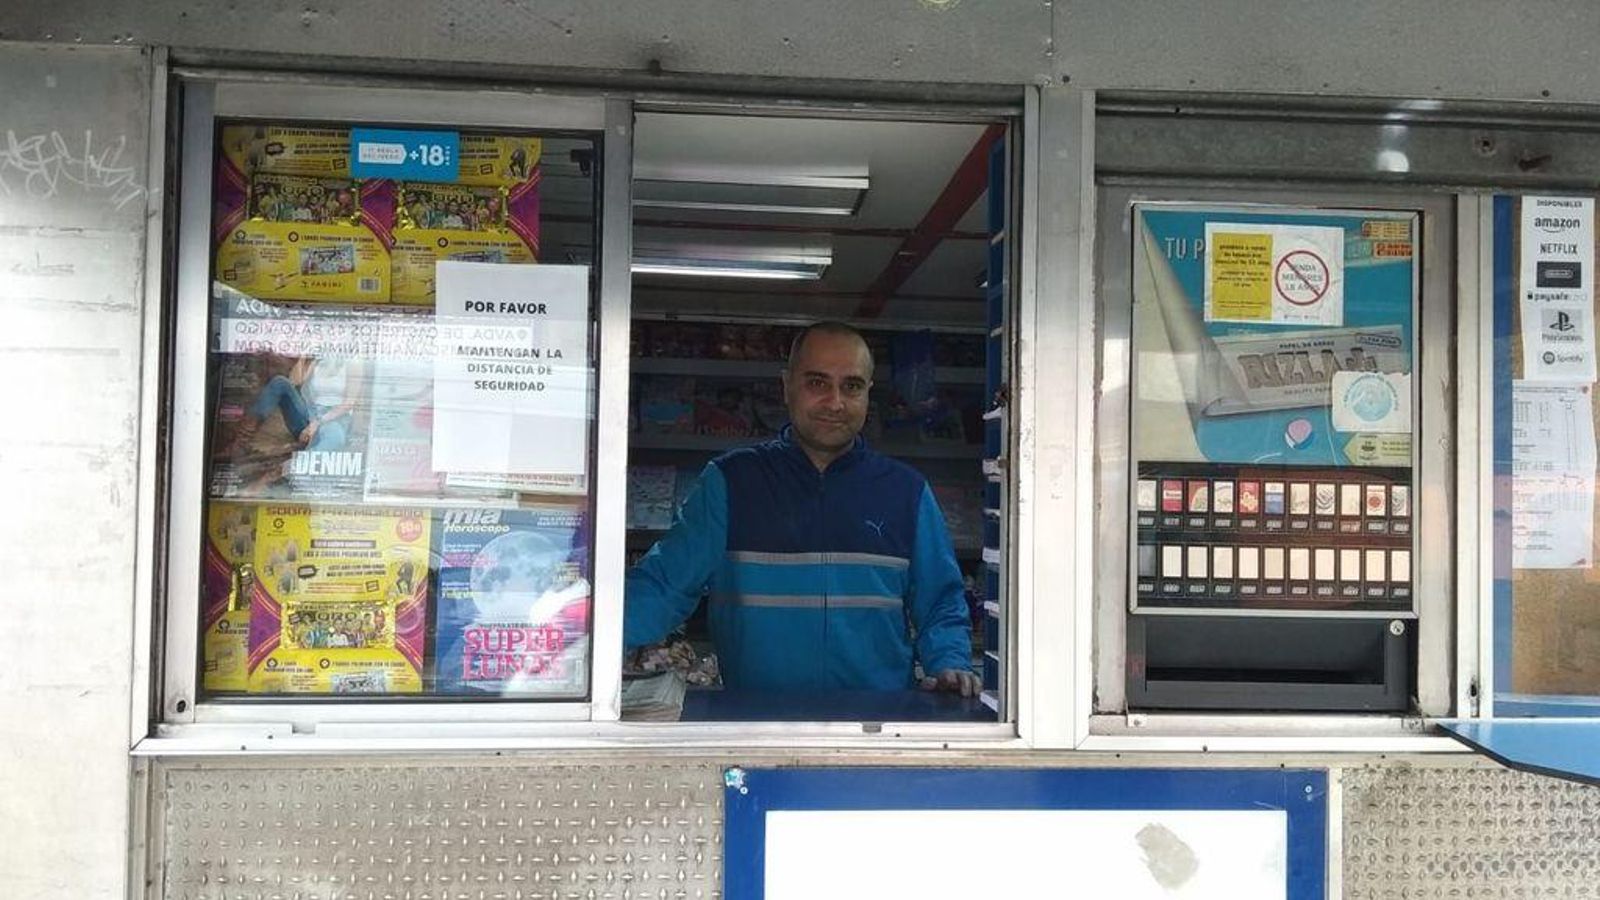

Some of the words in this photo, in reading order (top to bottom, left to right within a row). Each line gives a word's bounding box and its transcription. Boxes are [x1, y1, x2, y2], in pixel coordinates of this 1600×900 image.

[409, 144, 446, 166] +18
[1536, 199, 1582, 208] DISPONIBLES
[1534, 216, 1580, 228] amazon
[1165, 237, 1187, 259] TU
[1540, 243, 1578, 255] NETFLIX
[465, 300, 496, 313] POR
[499, 302, 547, 315] FAVOR
[457, 345, 540, 358] MANTENGAN
[547, 348, 563, 359] LA
[467, 362, 534, 375] DISTANCIA
[537, 363, 553, 375] DE
[474, 380, 545, 392] SEGURIDAD
[295, 450, 363, 476] DENIM
[463, 627, 565, 653] SUPER
